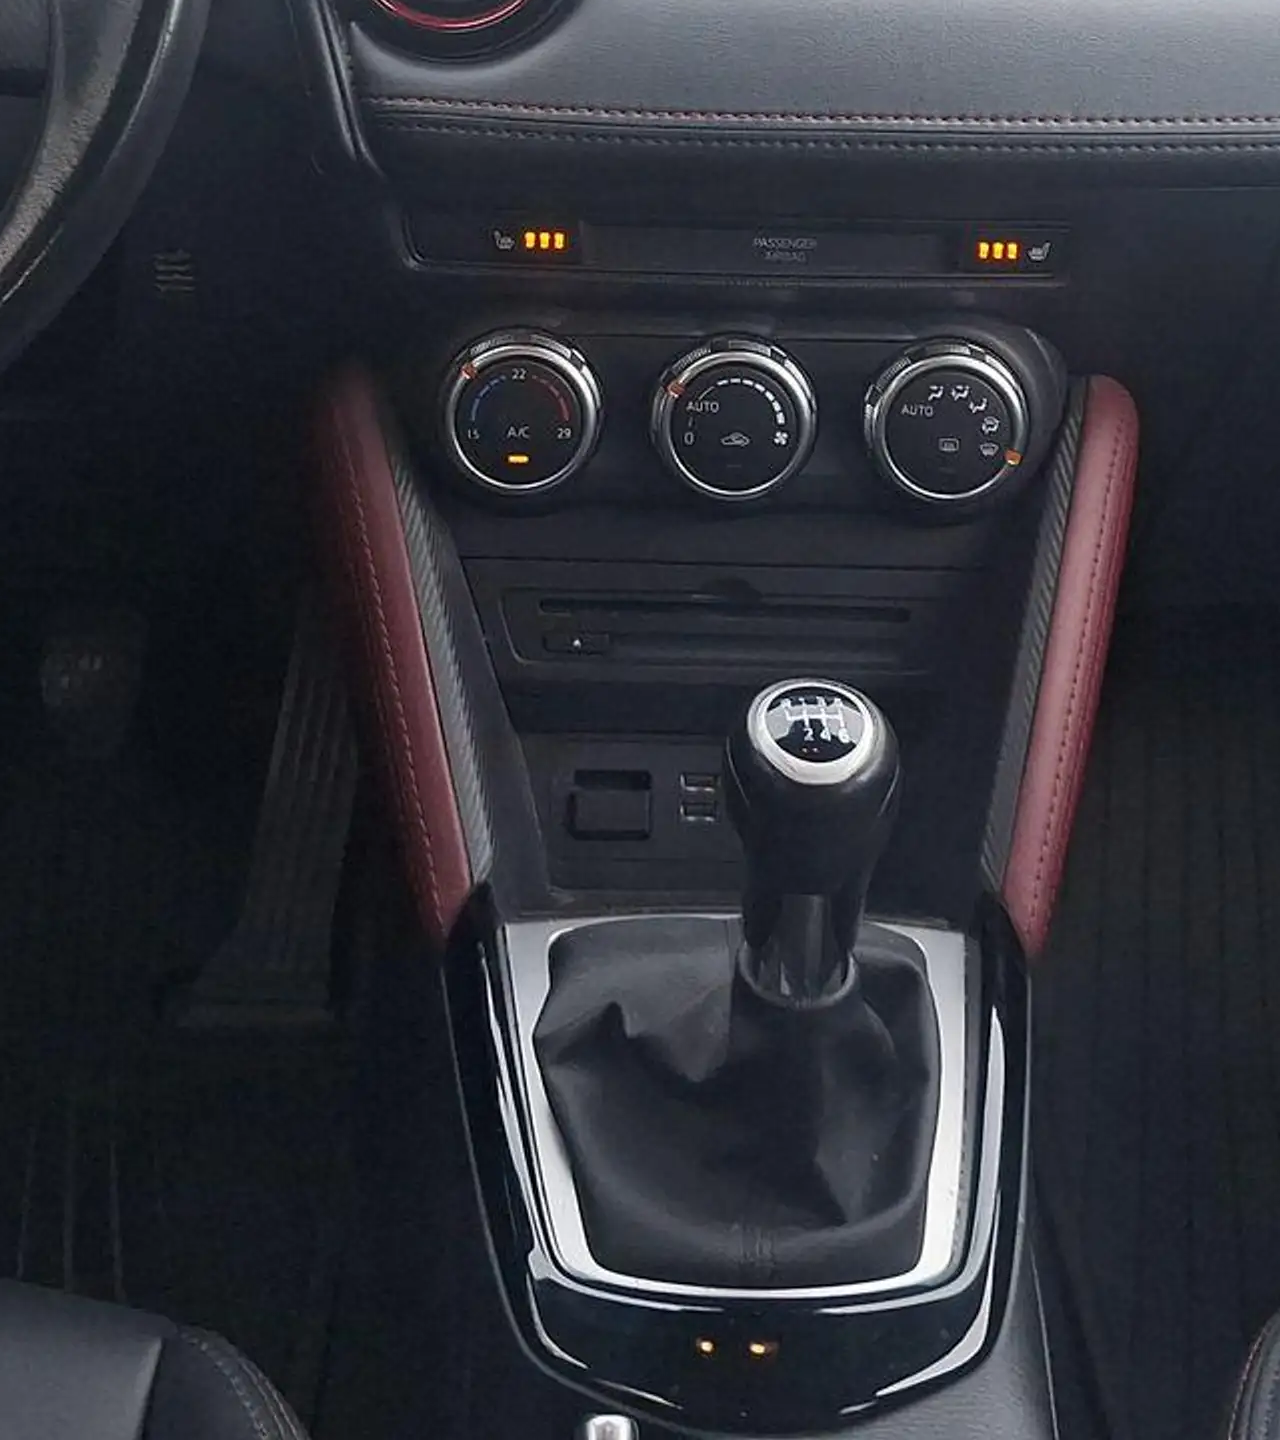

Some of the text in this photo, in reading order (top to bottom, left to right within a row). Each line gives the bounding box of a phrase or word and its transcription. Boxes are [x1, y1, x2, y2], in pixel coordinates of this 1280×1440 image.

[511, 367, 527, 380] 22
[686, 401, 719, 413] AUTO
[901, 404, 934, 417] AUTO
[467, 428, 480, 440] 15
[506, 425, 531, 439] A/C
[556, 427, 572, 440] 29
[803, 726, 850, 744] 2 4 6
